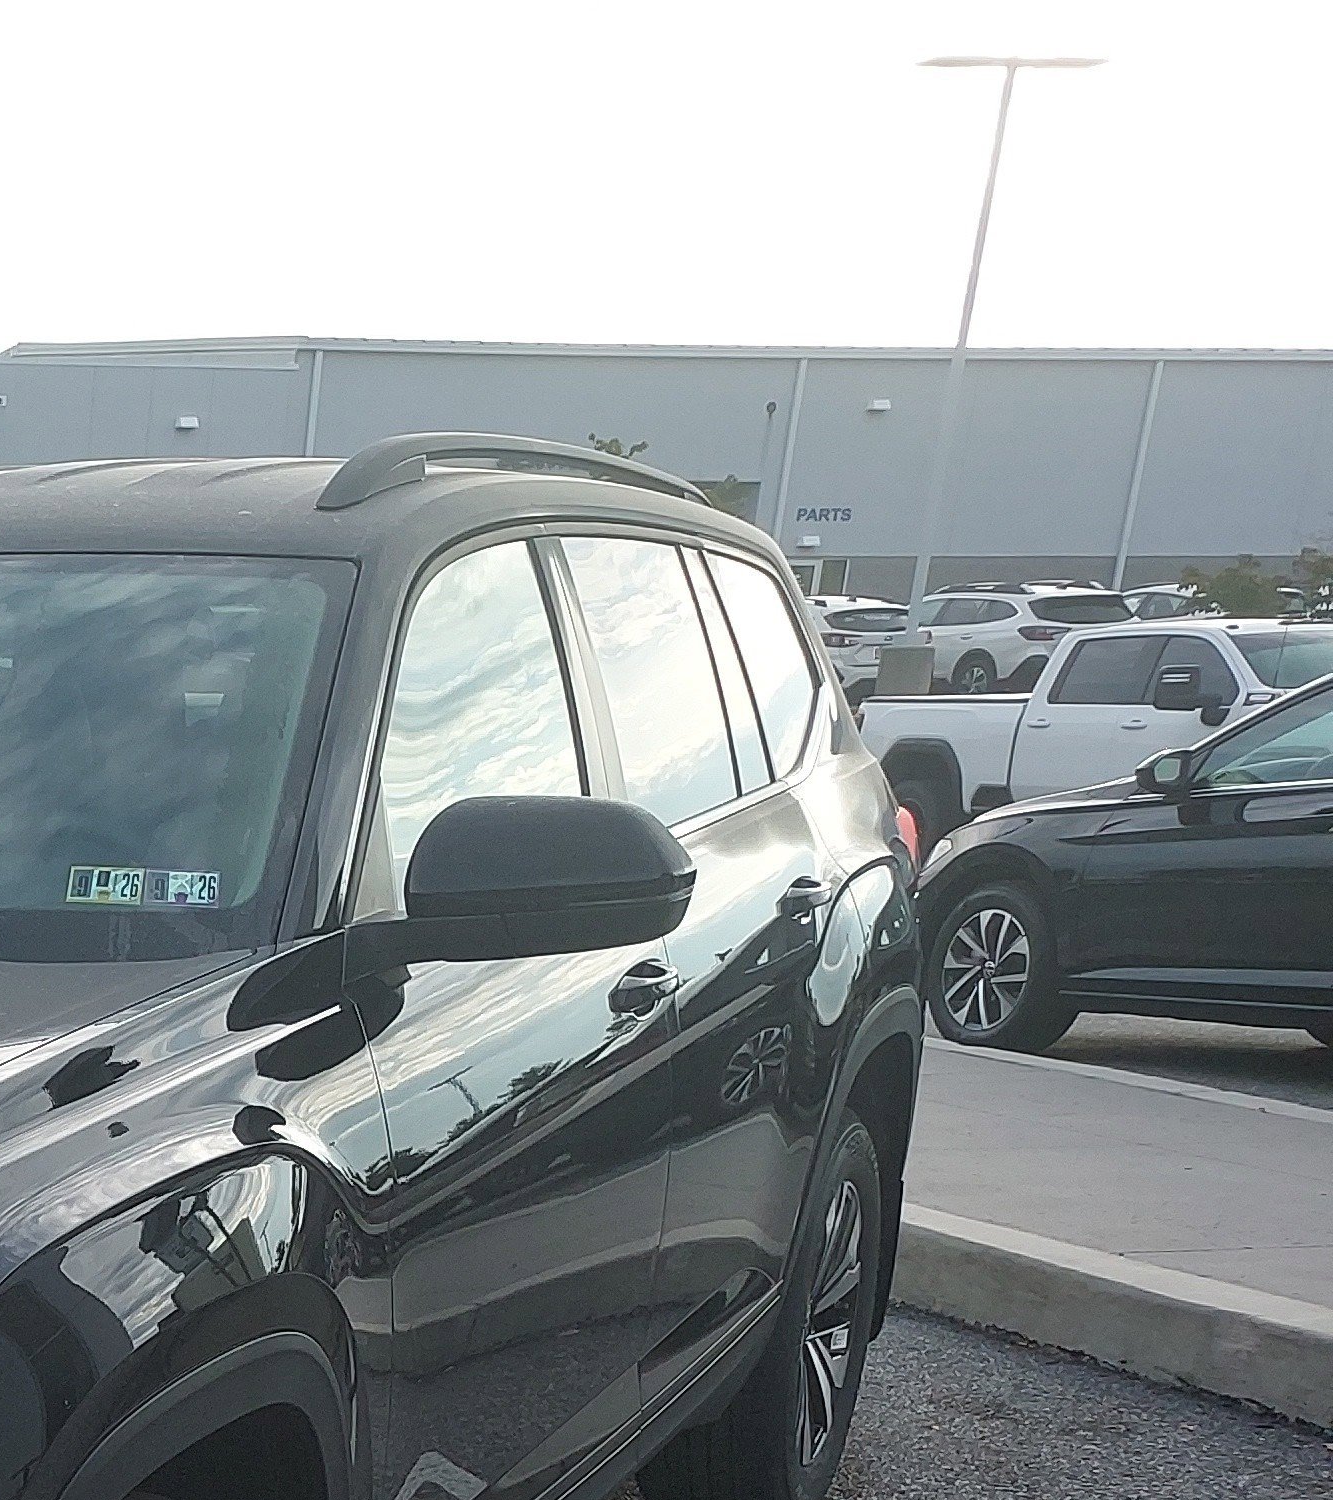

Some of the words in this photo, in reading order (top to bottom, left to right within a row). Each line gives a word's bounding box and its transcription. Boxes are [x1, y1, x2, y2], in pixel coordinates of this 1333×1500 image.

[796, 507, 852, 522] PARTS
[120, 872, 140, 898] 26
[197, 875, 217, 900] 26
